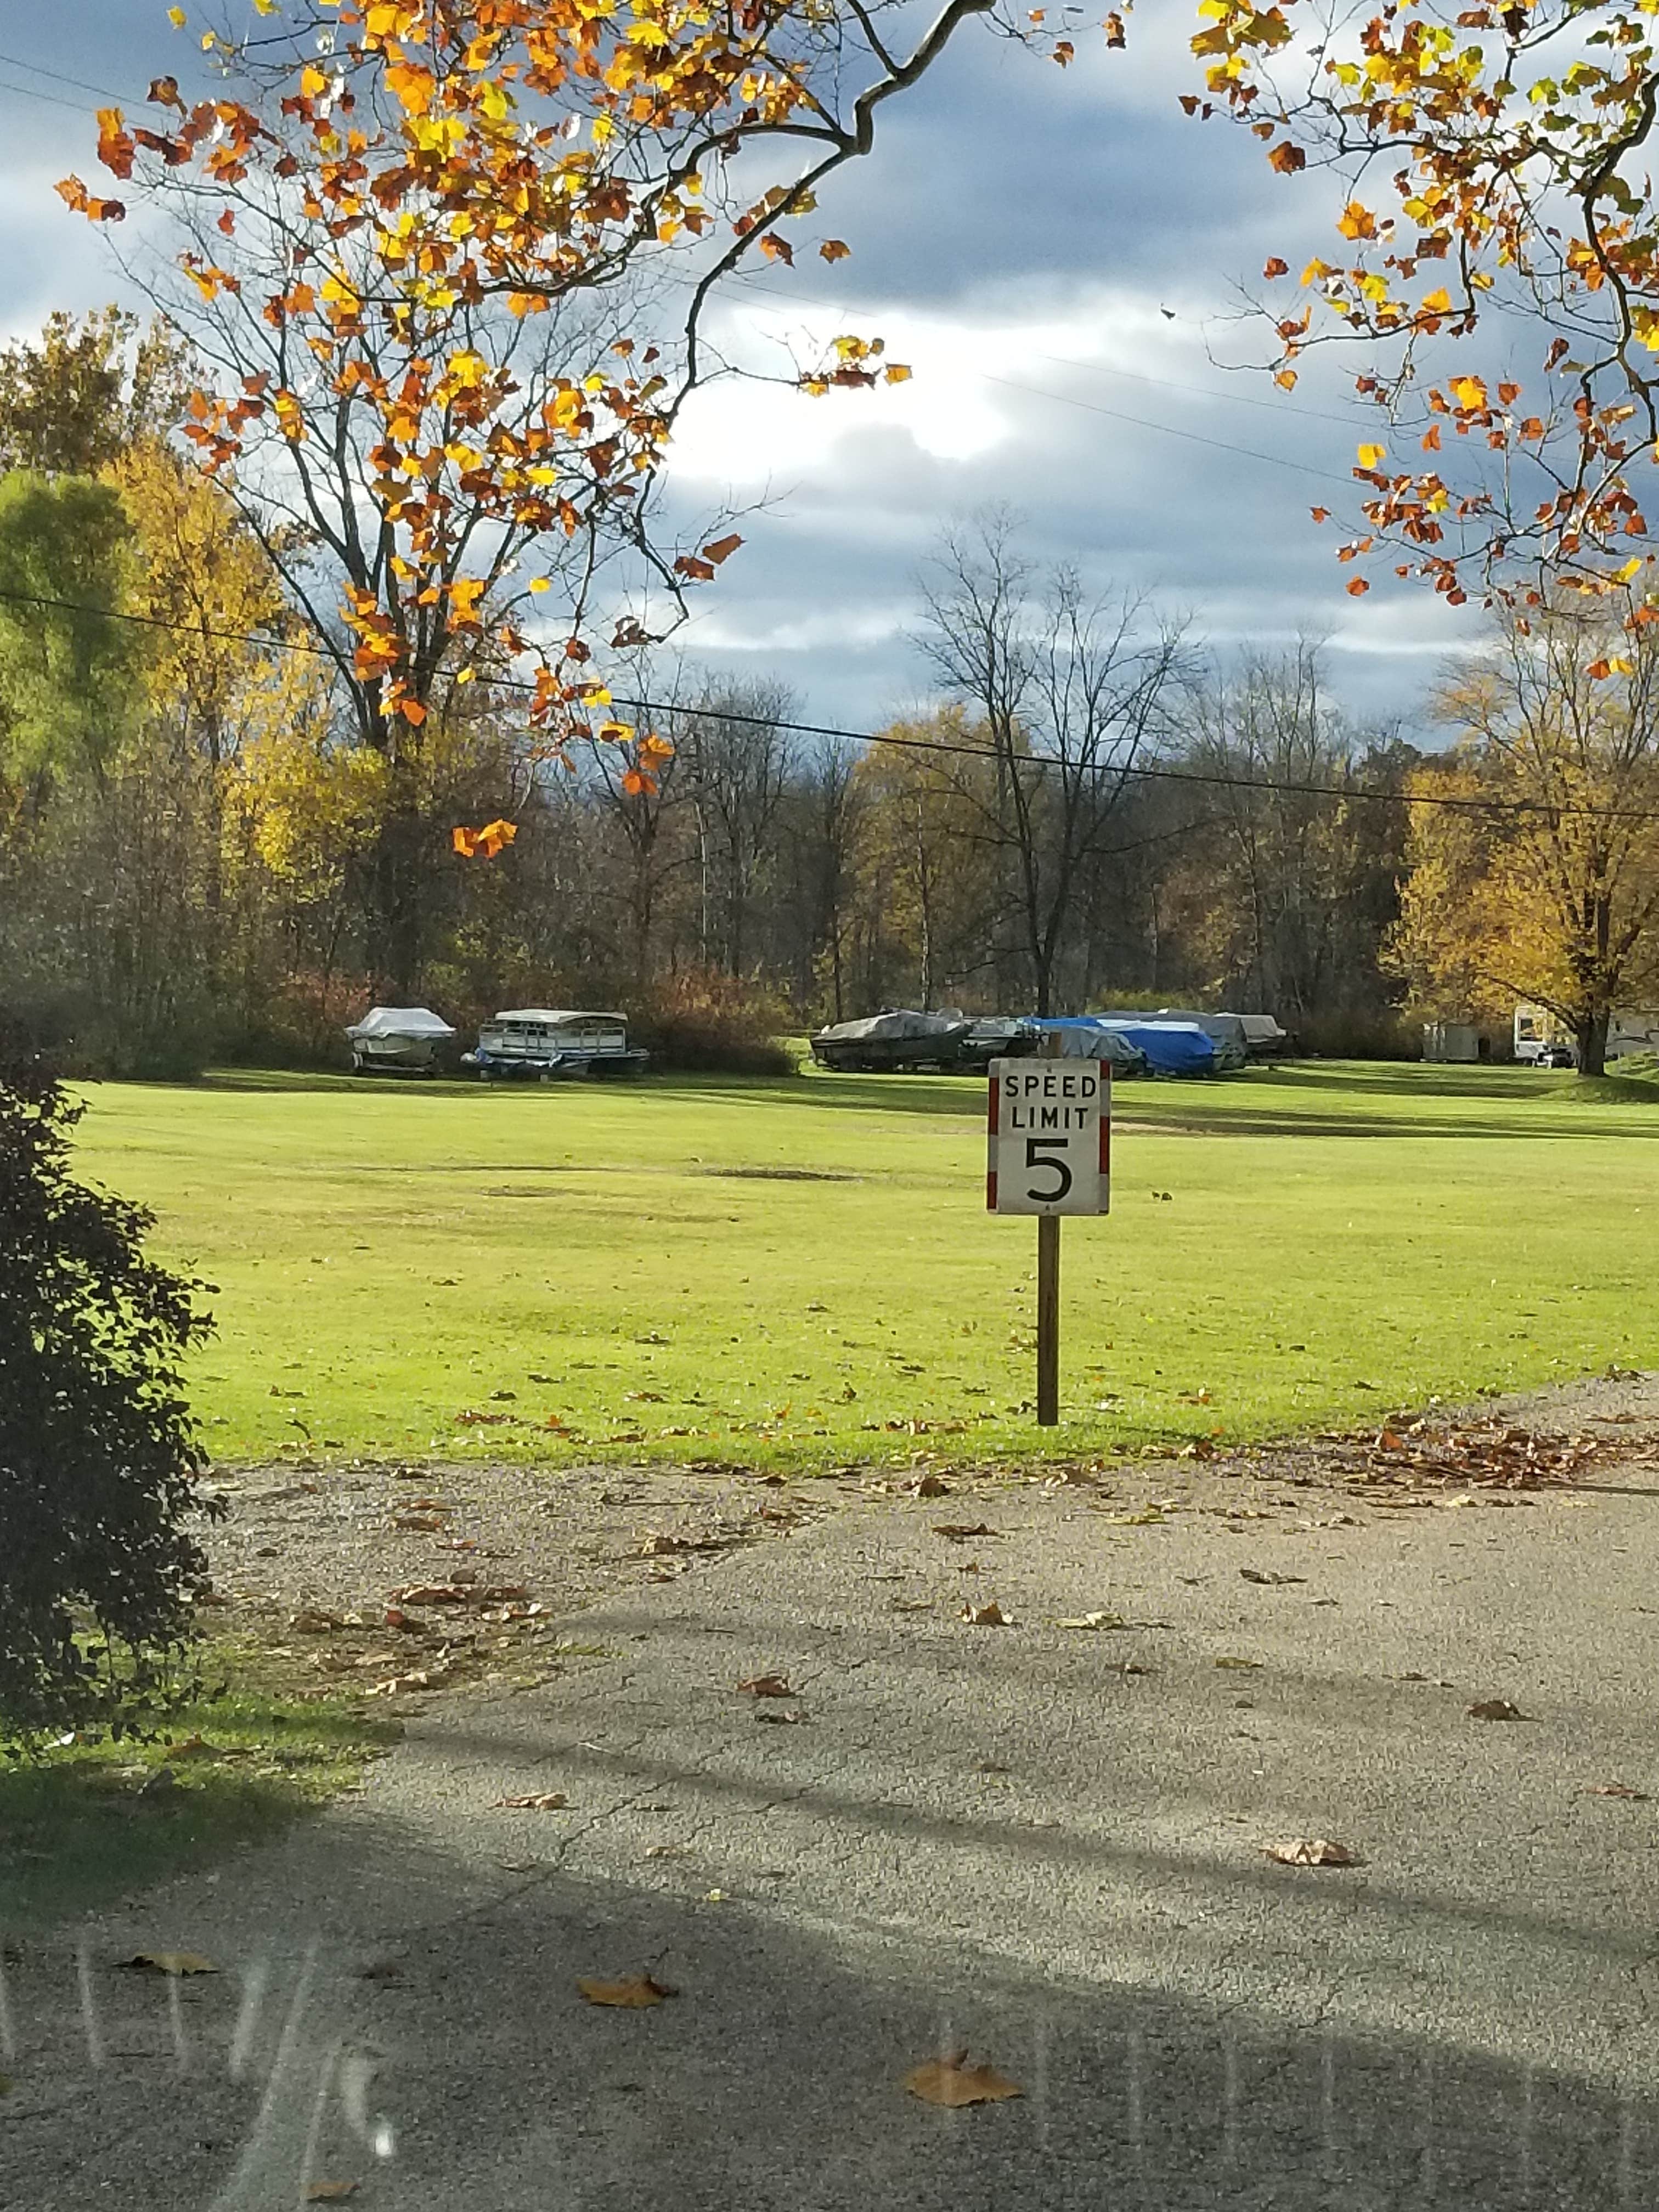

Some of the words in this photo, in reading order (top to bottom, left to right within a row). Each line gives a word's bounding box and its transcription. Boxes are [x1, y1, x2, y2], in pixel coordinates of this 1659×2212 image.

[1005, 1075, 1096, 1098] SPEED
[1012, 1107, 1088, 1129] LIMIT
[1026, 1138, 1073, 1202] 5
